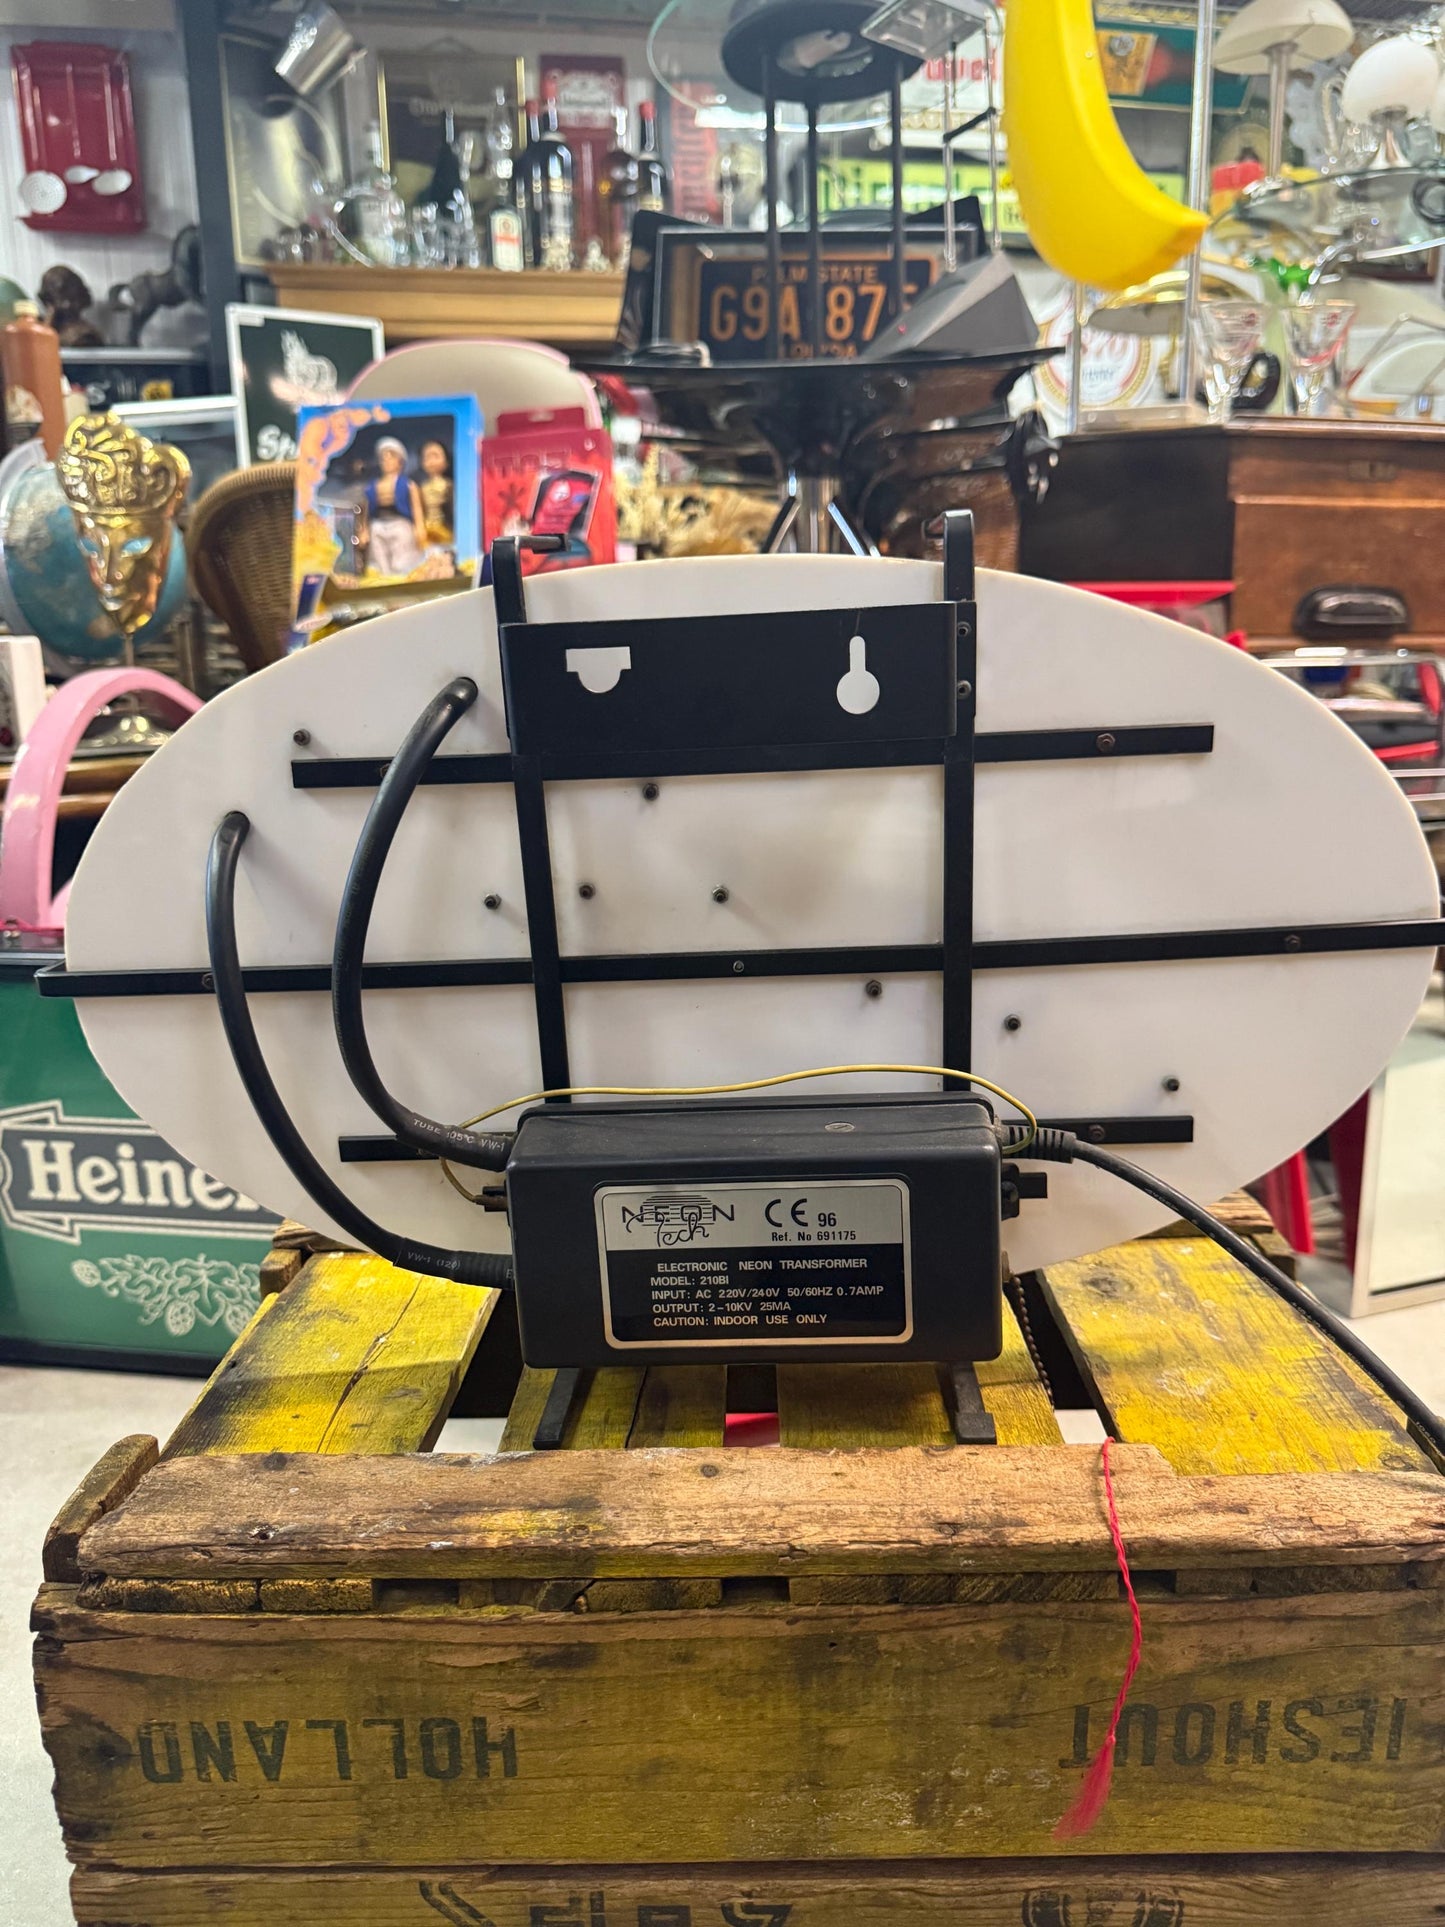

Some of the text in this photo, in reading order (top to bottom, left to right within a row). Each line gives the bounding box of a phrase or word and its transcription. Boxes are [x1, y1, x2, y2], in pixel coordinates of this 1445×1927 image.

[710, 285, 800, 341] G9A
[413, 1118, 441, 1135] TUBE
[480, 1138, 505, 1152] VW-1
[21, 1140, 260, 1211] Heine
[622, 1204, 734, 1224] NEON
[765, 1198, 837, 1227] CE 96
[626, 1211, 709, 1247] Tech
[772, 1231, 856, 1241] Ref. No 691175
[657, 1258, 867, 1273] ELECTRONIC NEON TRANSFORMER
[650, 1276, 696, 1286] MODEL:
[651, 1285, 884, 1300] INPUT: AC 220V/240V 50/60HZ 0.7AMP
[652, 1301, 792, 1314] OUTPUT: 2-10KV 25MA
[653, 1314, 828, 1327] CAUTION: INDOOR USE ONLY
[137, 1716, 518, 1784] HOLLAND
